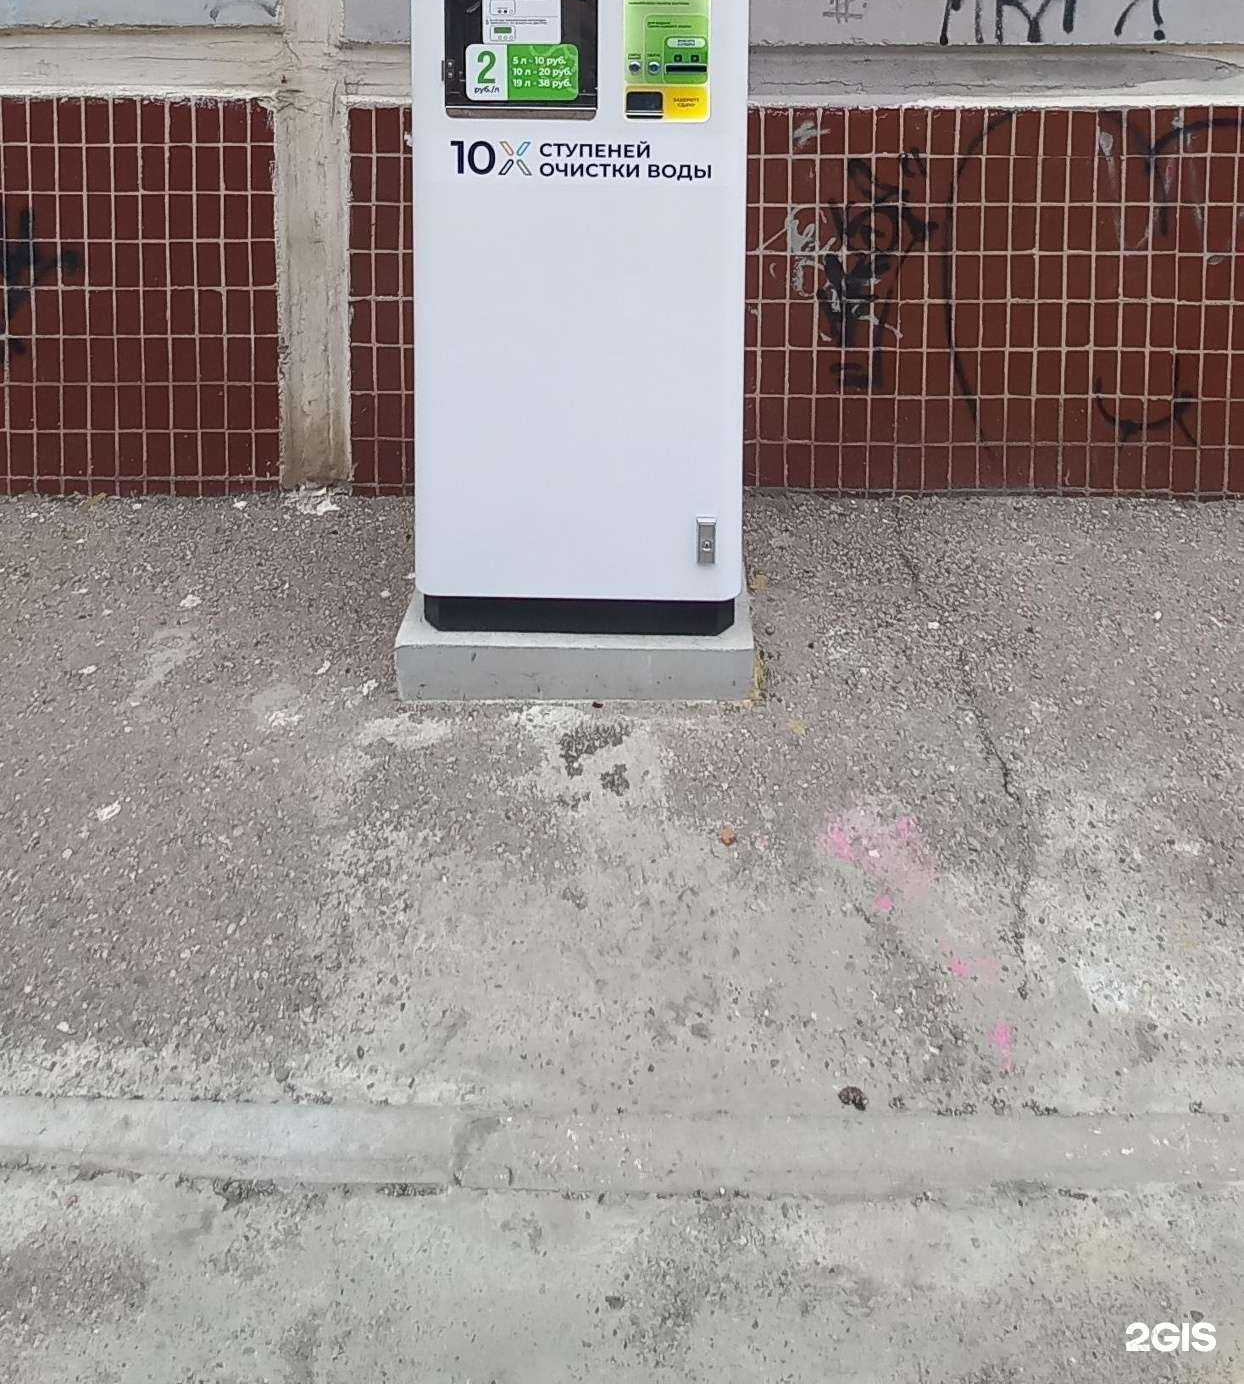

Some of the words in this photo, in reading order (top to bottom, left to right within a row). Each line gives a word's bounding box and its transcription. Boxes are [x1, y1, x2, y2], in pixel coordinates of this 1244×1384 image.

[477, 50, 496, 84] 2
[546, 56, 566, 66] руб.
[512, 68, 523, 76] 10
[538, 68, 551, 76] 20
[552, 68, 572, 77] руб.
[512, 79, 523, 87] 19
[538, 79, 550, 87] 38
[552, 79, 572, 88] руб.
[539, 140, 651, 159] СТУПЕНЕЙ
[539, 162, 640, 178] ОЧИСТКИ
[649, 163, 712, 181] ВОДЫ
